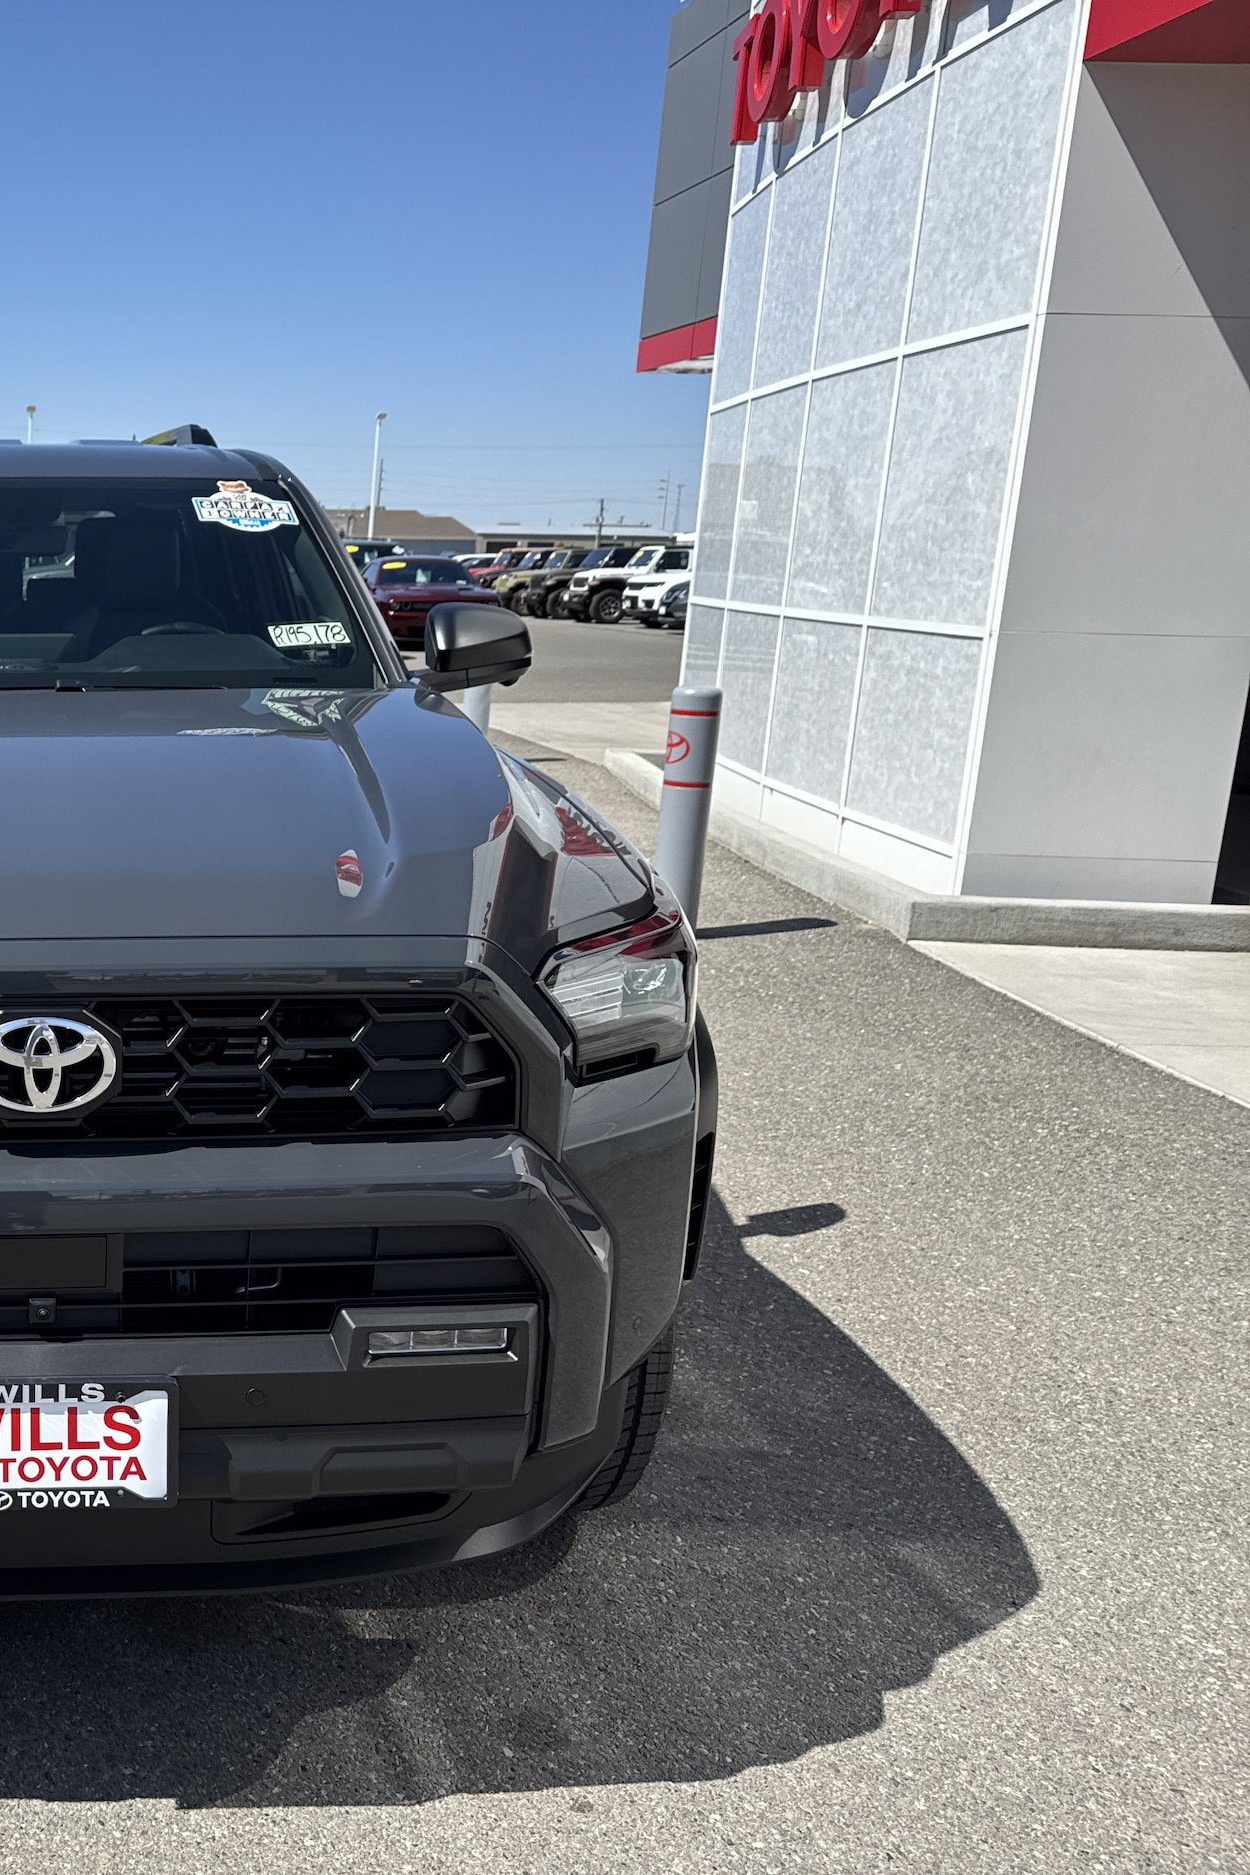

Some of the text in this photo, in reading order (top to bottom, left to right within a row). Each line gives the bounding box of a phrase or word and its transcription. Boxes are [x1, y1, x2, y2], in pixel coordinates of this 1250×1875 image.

[201, 500, 288, 512] CARFAX
[219, 510, 290, 520] OWNER
[17, 1490, 111, 1508] TOYOTA
